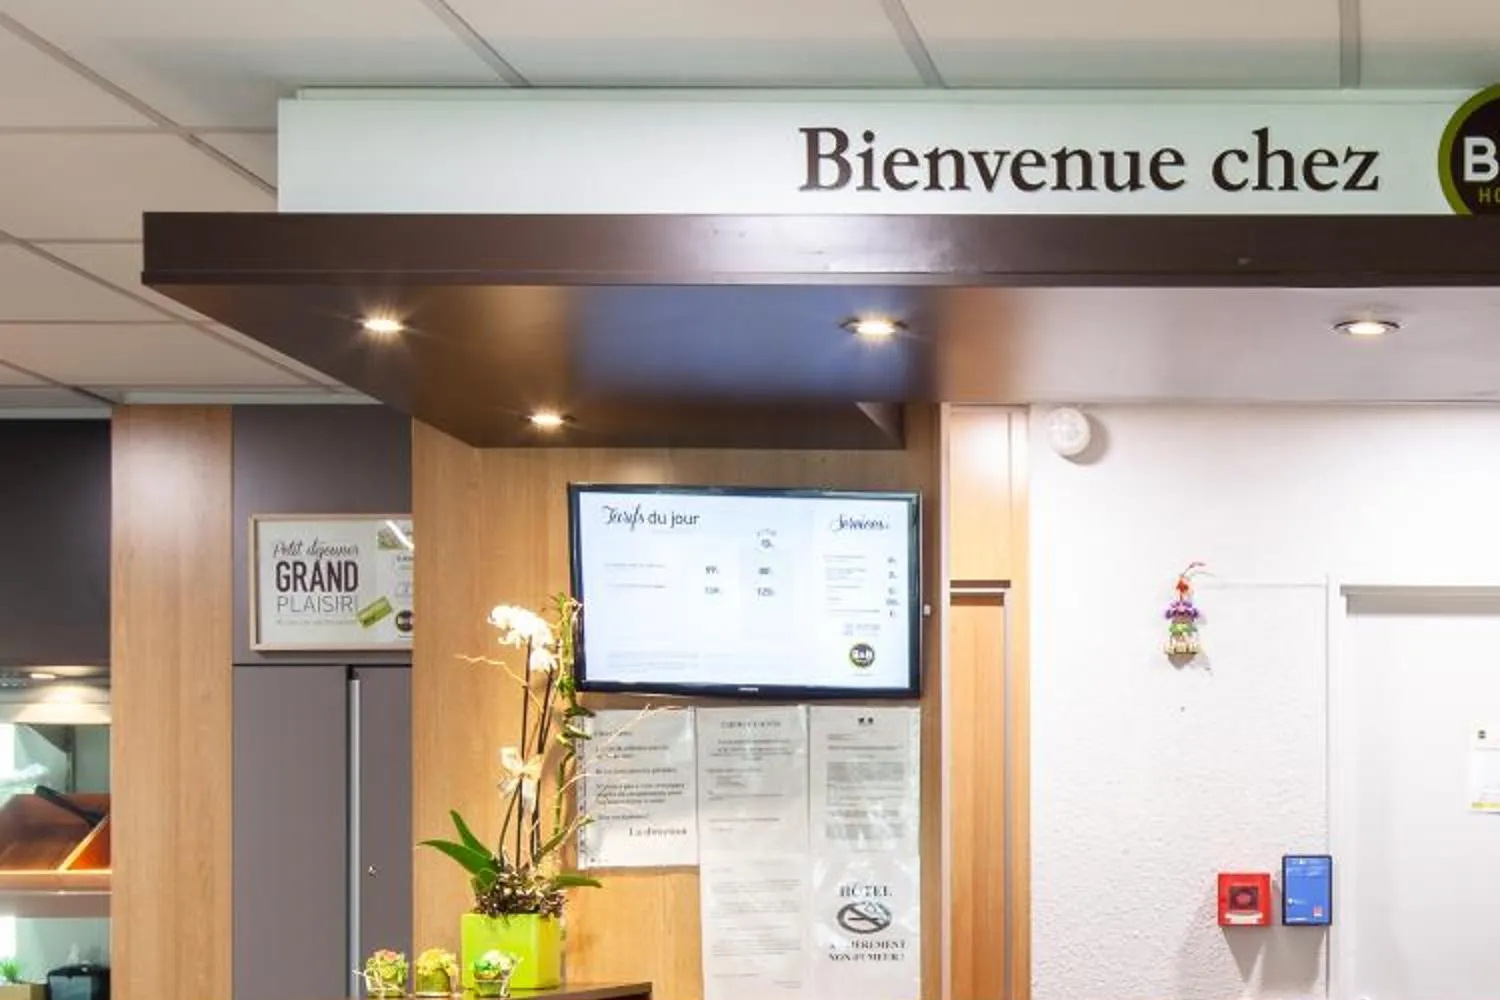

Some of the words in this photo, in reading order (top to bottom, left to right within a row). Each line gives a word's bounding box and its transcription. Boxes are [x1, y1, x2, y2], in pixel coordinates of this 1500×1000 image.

[797, 126, 1185, 192] Bienvenue
[1211, 127, 1381, 192] chez
[649, 510, 668, 525] du
[671, 510, 701, 529] jour
[275, 560, 360, 593] GRAND
